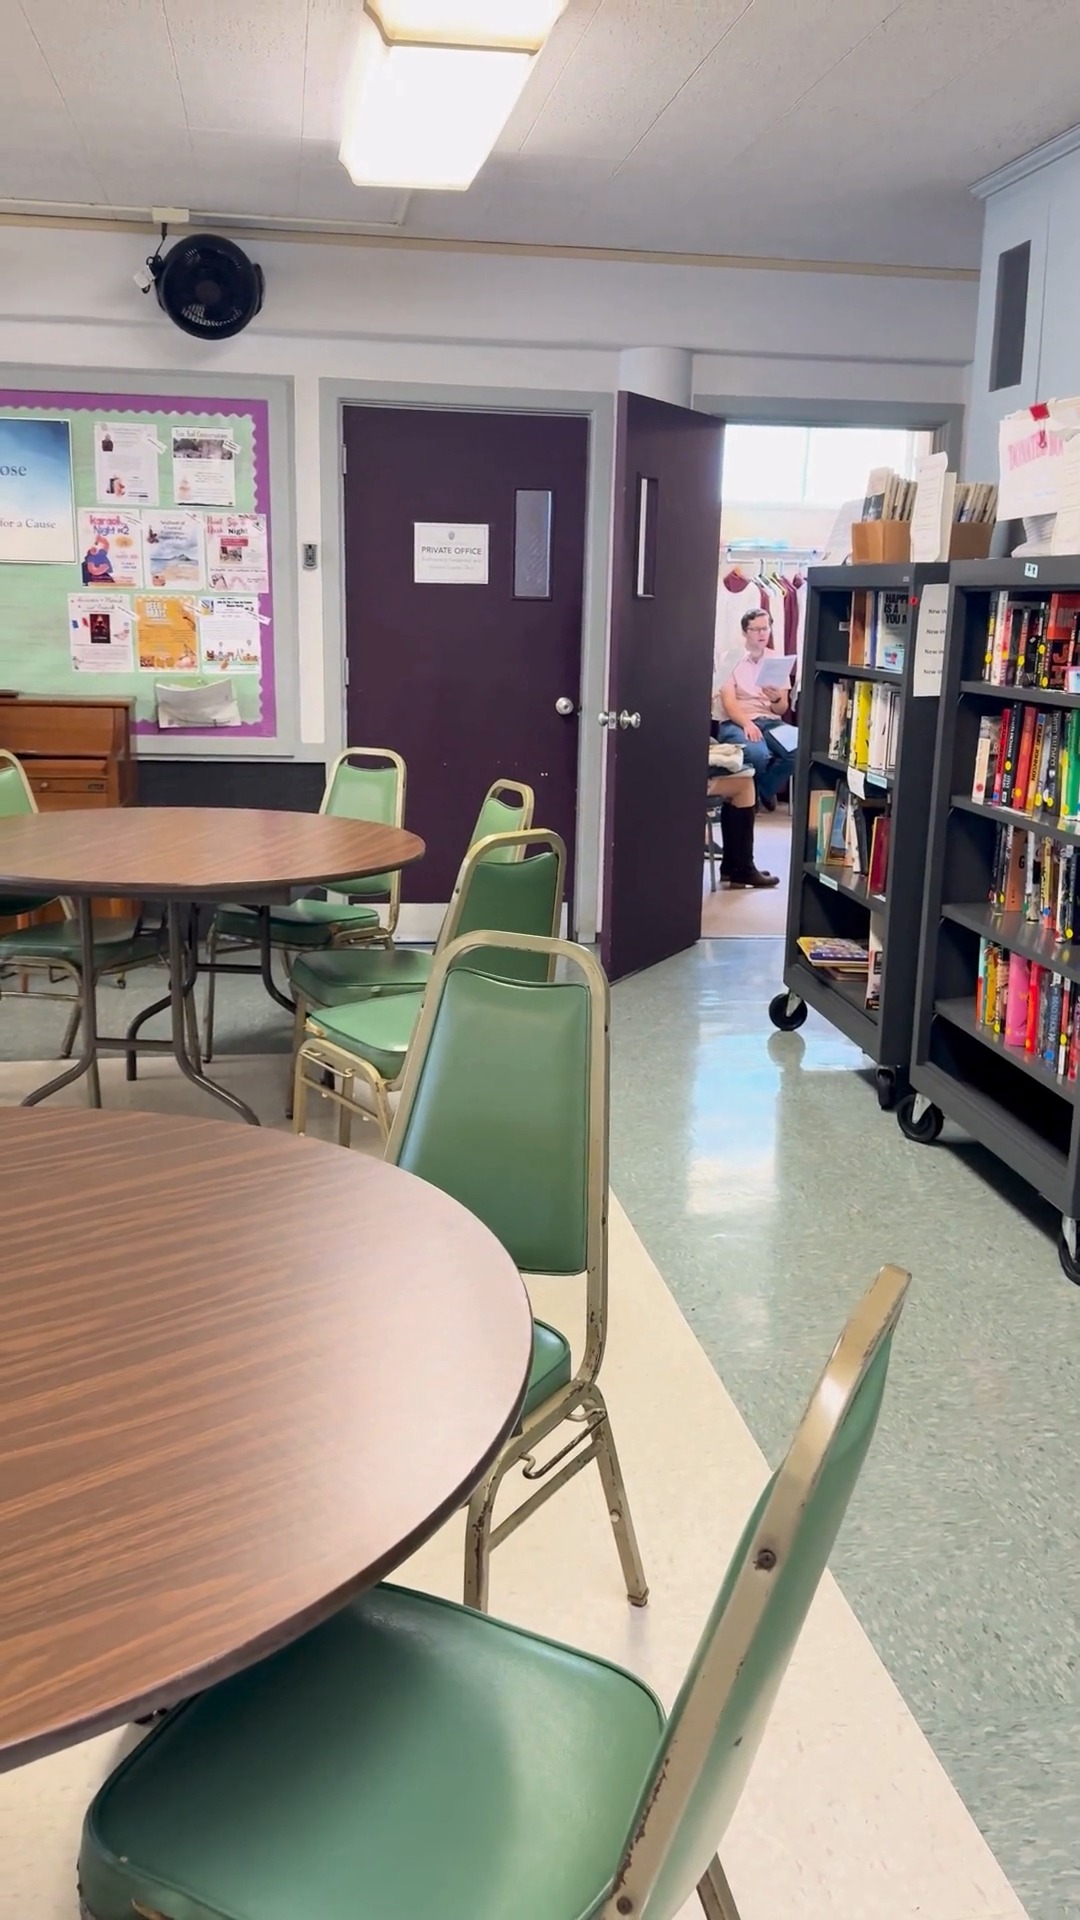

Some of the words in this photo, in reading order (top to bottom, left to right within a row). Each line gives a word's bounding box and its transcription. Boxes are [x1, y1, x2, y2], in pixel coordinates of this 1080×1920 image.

[25, 518, 56, 528] Cause
[94, 525, 116, 536] Night
[421, 546, 452, 554] PRIVATE
[454, 547, 482, 556] OFFICE
[884, 604, 892, 614] IS
[893, 604, 898, 614] A
[886, 614, 900, 624] YOU
[1050, 735, 1058, 766] BALDACCI
[1031, 746, 1040, 782] JOHNSON
